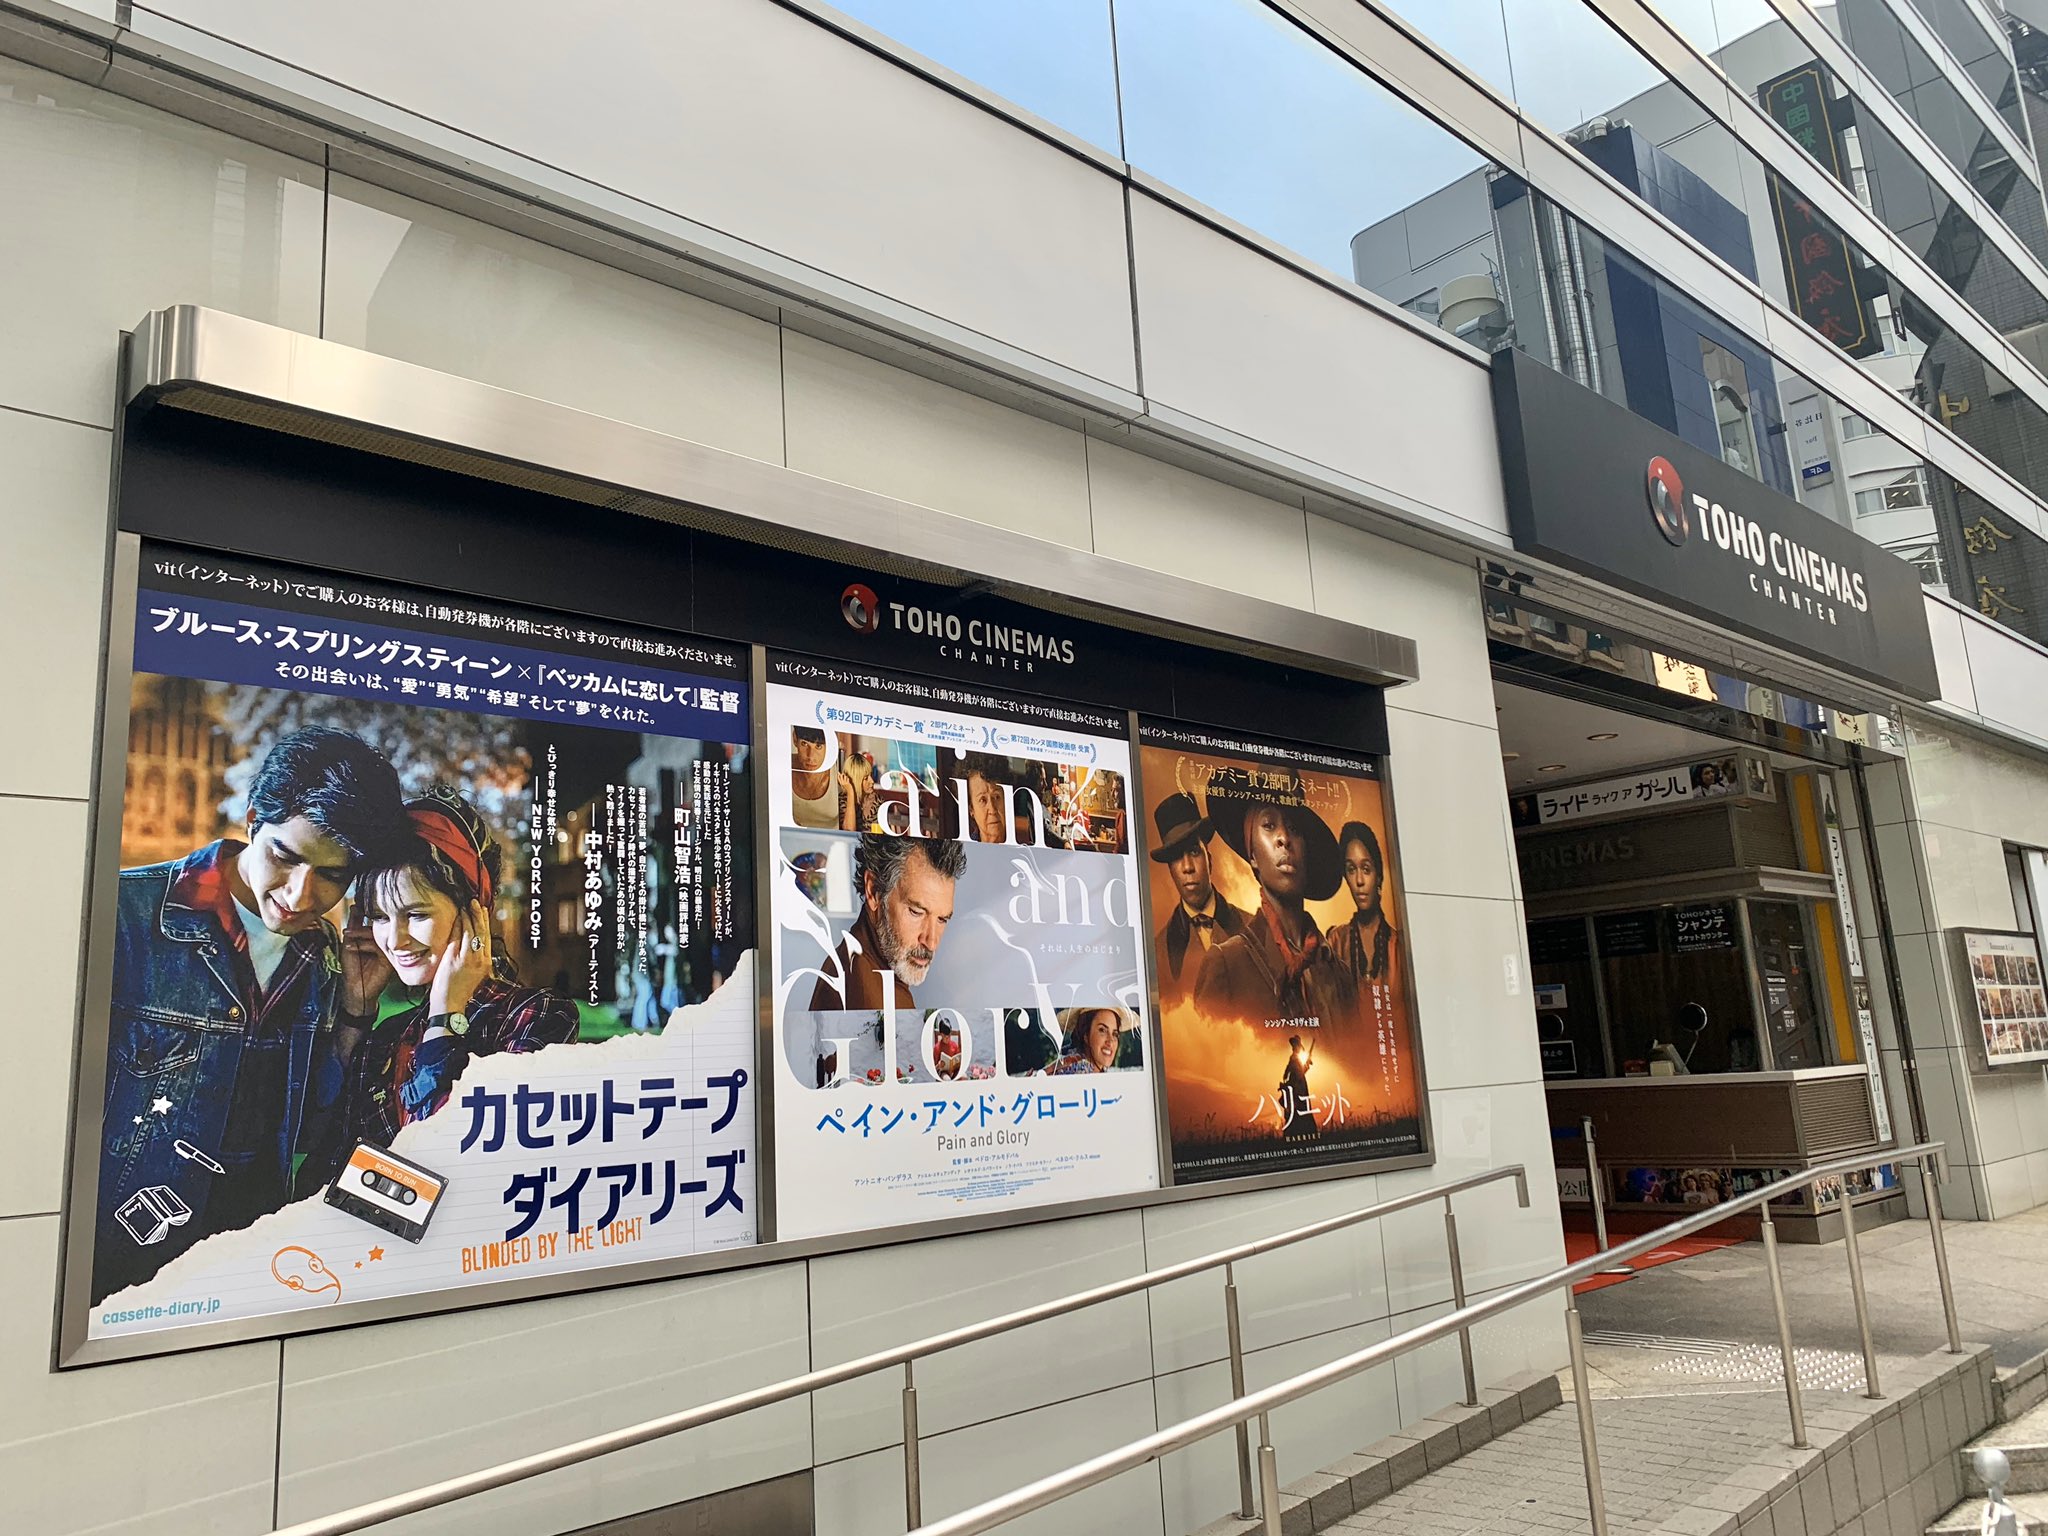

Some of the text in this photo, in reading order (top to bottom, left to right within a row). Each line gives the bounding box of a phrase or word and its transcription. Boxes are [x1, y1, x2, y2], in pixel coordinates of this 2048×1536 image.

[1692, 493, 1869, 613] TOHO CINEMAS
[1748, 573, 1838, 627] CHANTER
[889, 602, 1075, 664] TOHO CINEMAS
[940, 645, 1034, 674] CHANTER
[530, 803, 543, 949] NEW YORK POST
[1677, 916, 1726, 932] シャンテ
[460, 1068, 749, 1155] カセットテープ
[1247, 1082, 1351, 1132] ハリエット
[937, 1129, 1031, 1151] Pain and Glory
[374, 1162, 417, 1187] BORN TO RUN
[503, 1148, 746, 1243] ダイアリーズ
[461, 1216, 643, 1274] BLINDED BY THE LIGHT
[102, 1296, 221, 1326] cassette-diary.jp
